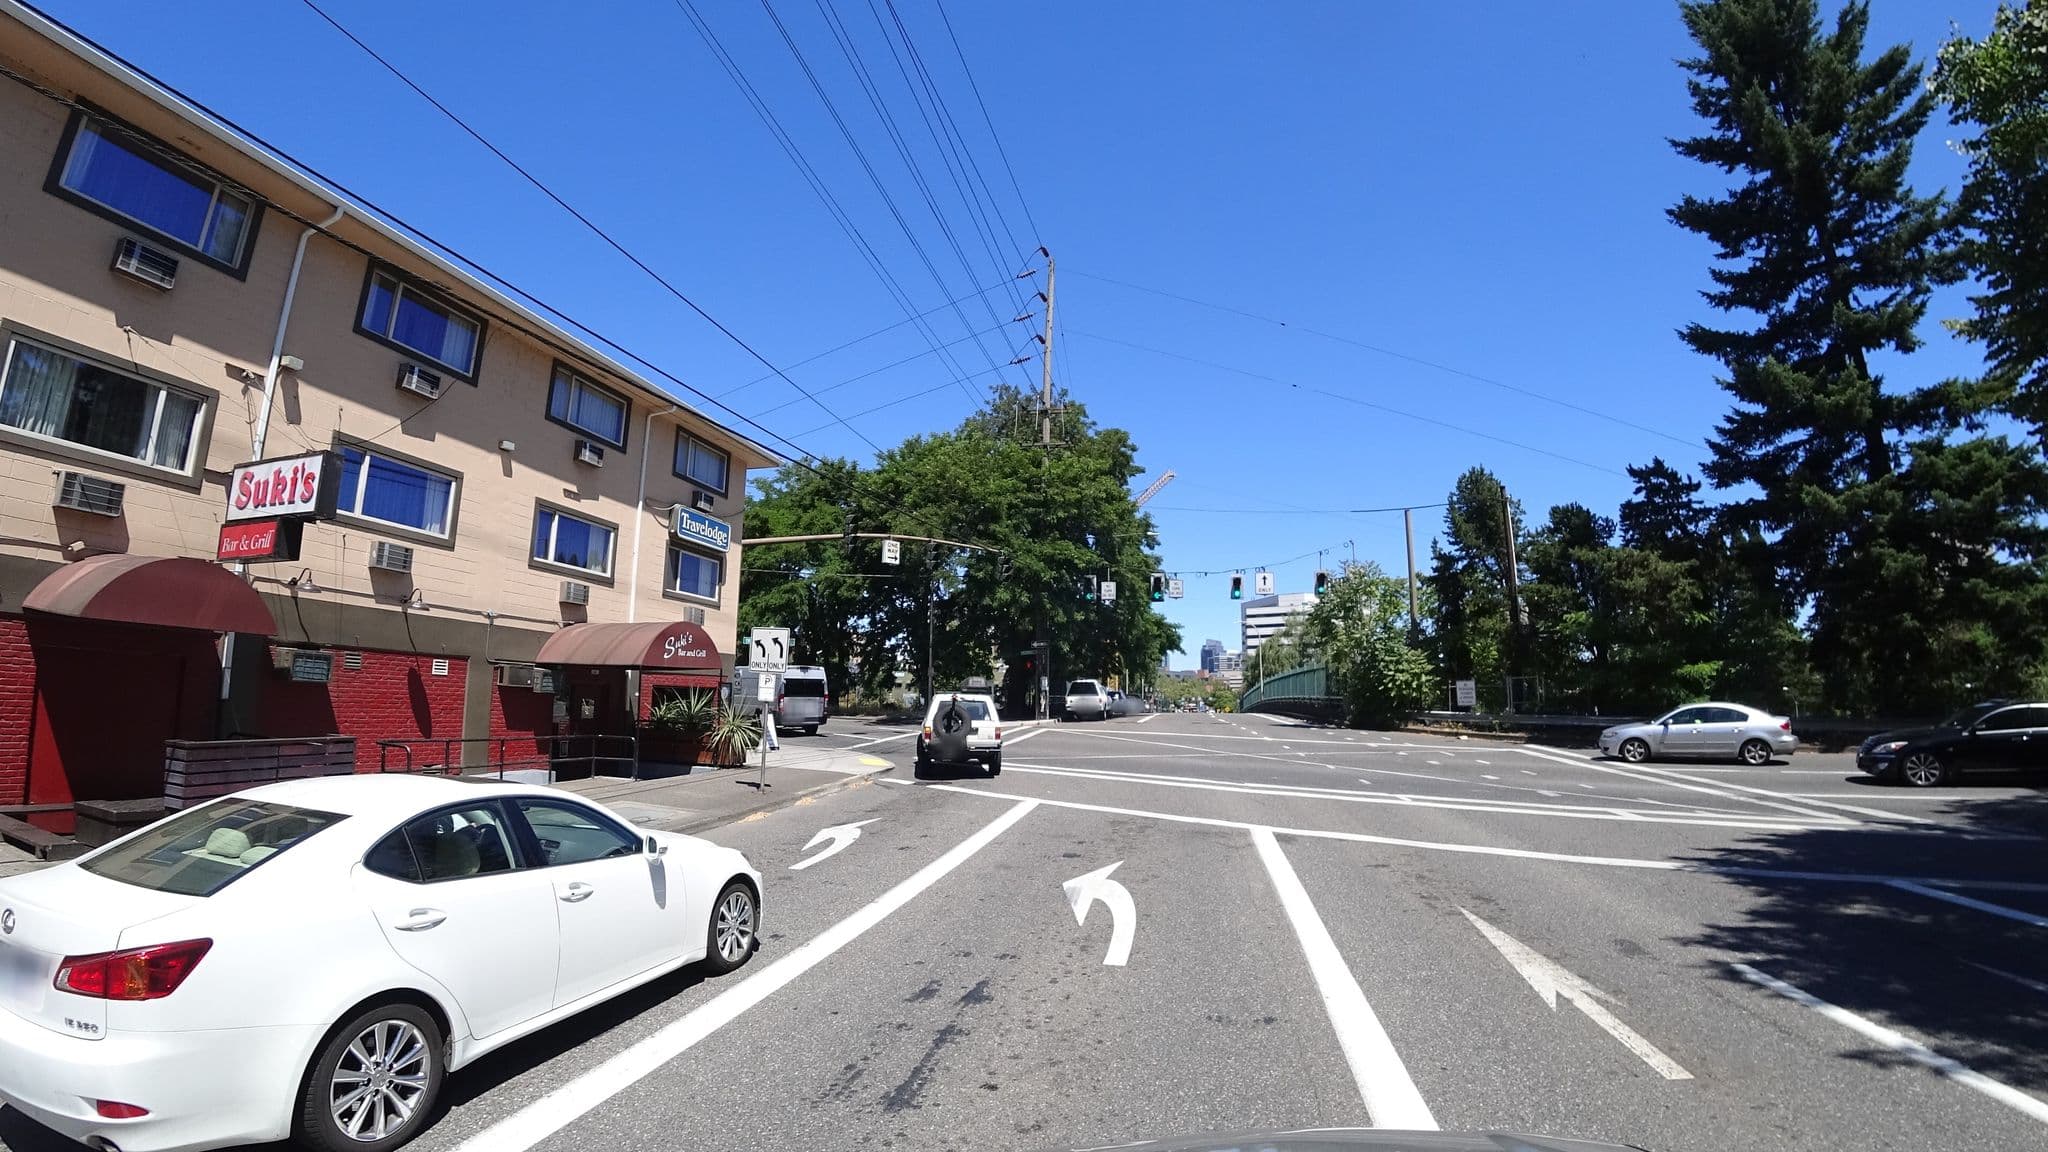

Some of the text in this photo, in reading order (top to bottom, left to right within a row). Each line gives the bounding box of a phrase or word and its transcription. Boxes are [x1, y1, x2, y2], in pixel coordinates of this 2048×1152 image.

[235, 462, 316, 510] Suki's
[222, 529, 275, 553] Bar & Grill
[681, 512, 728, 545] Travelodge
[663, 631, 693, 659] Suki's
[678, 648, 686, 656] Bar
[696, 649, 706, 657] Grill
[752, 661, 784, 670] ONLY ONLY
